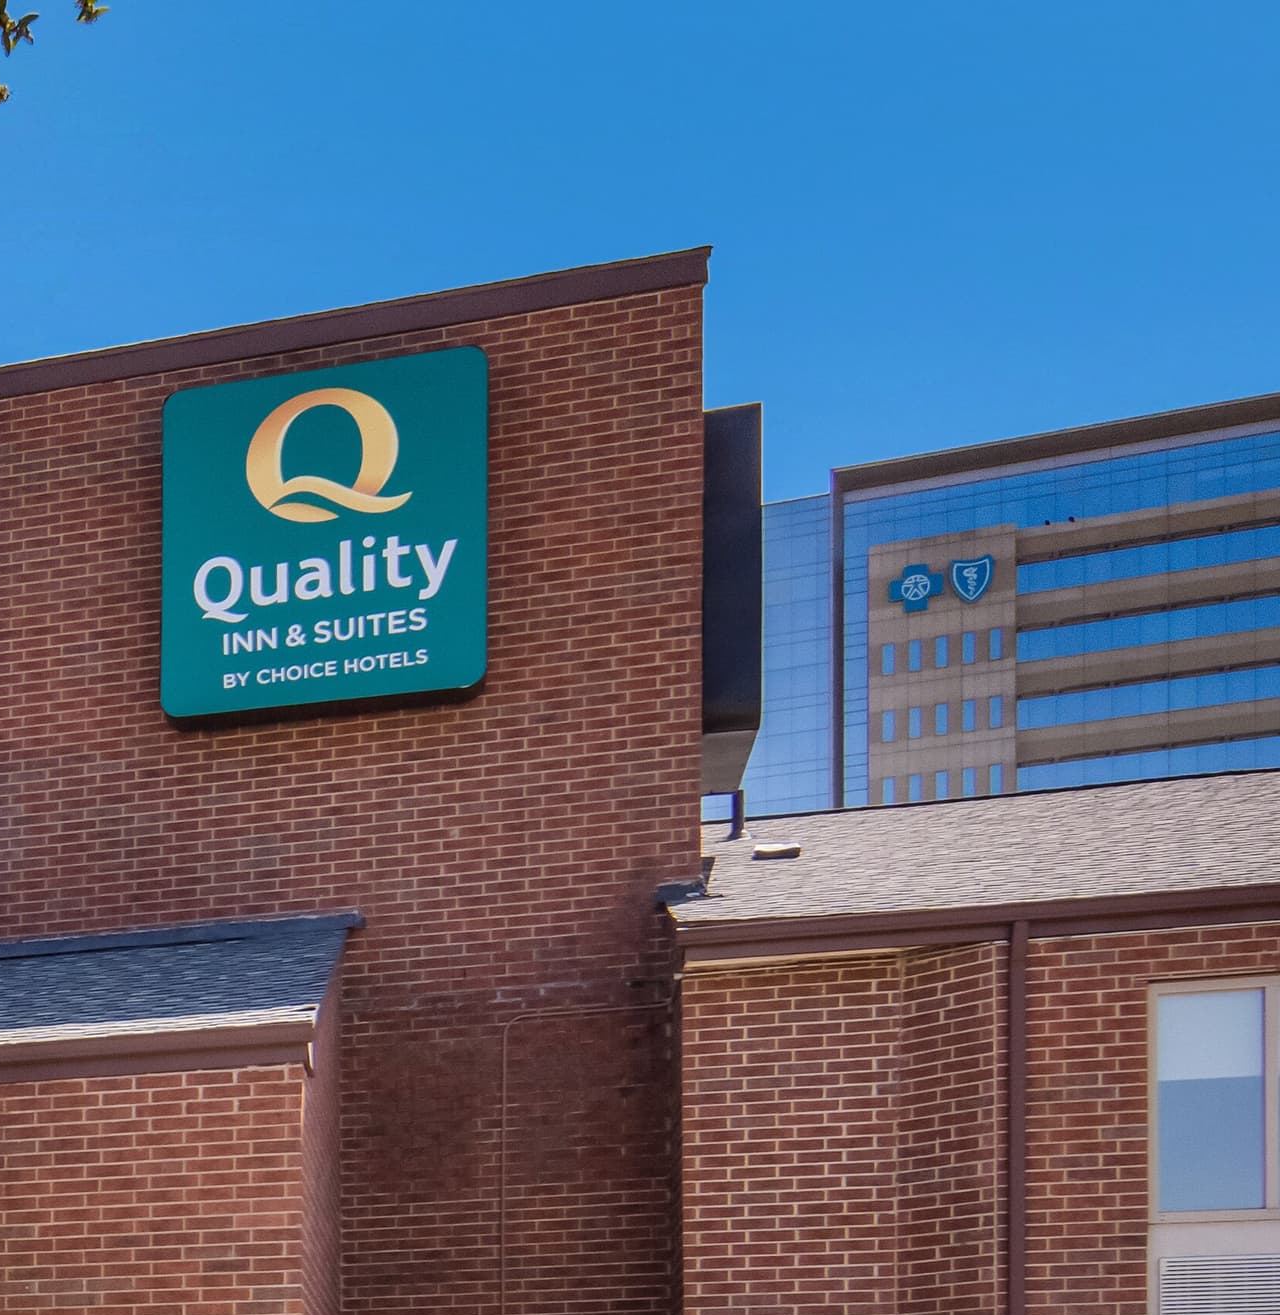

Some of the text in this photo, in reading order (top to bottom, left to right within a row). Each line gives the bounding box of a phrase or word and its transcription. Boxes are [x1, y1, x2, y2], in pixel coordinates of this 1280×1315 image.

[246, 387, 413, 523] Q
[193, 535, 458, 623] Quality
[222, 607, 429, 656] INN & SUITES
[223, 649, 429, 689] BY CHOICE HOTELS
